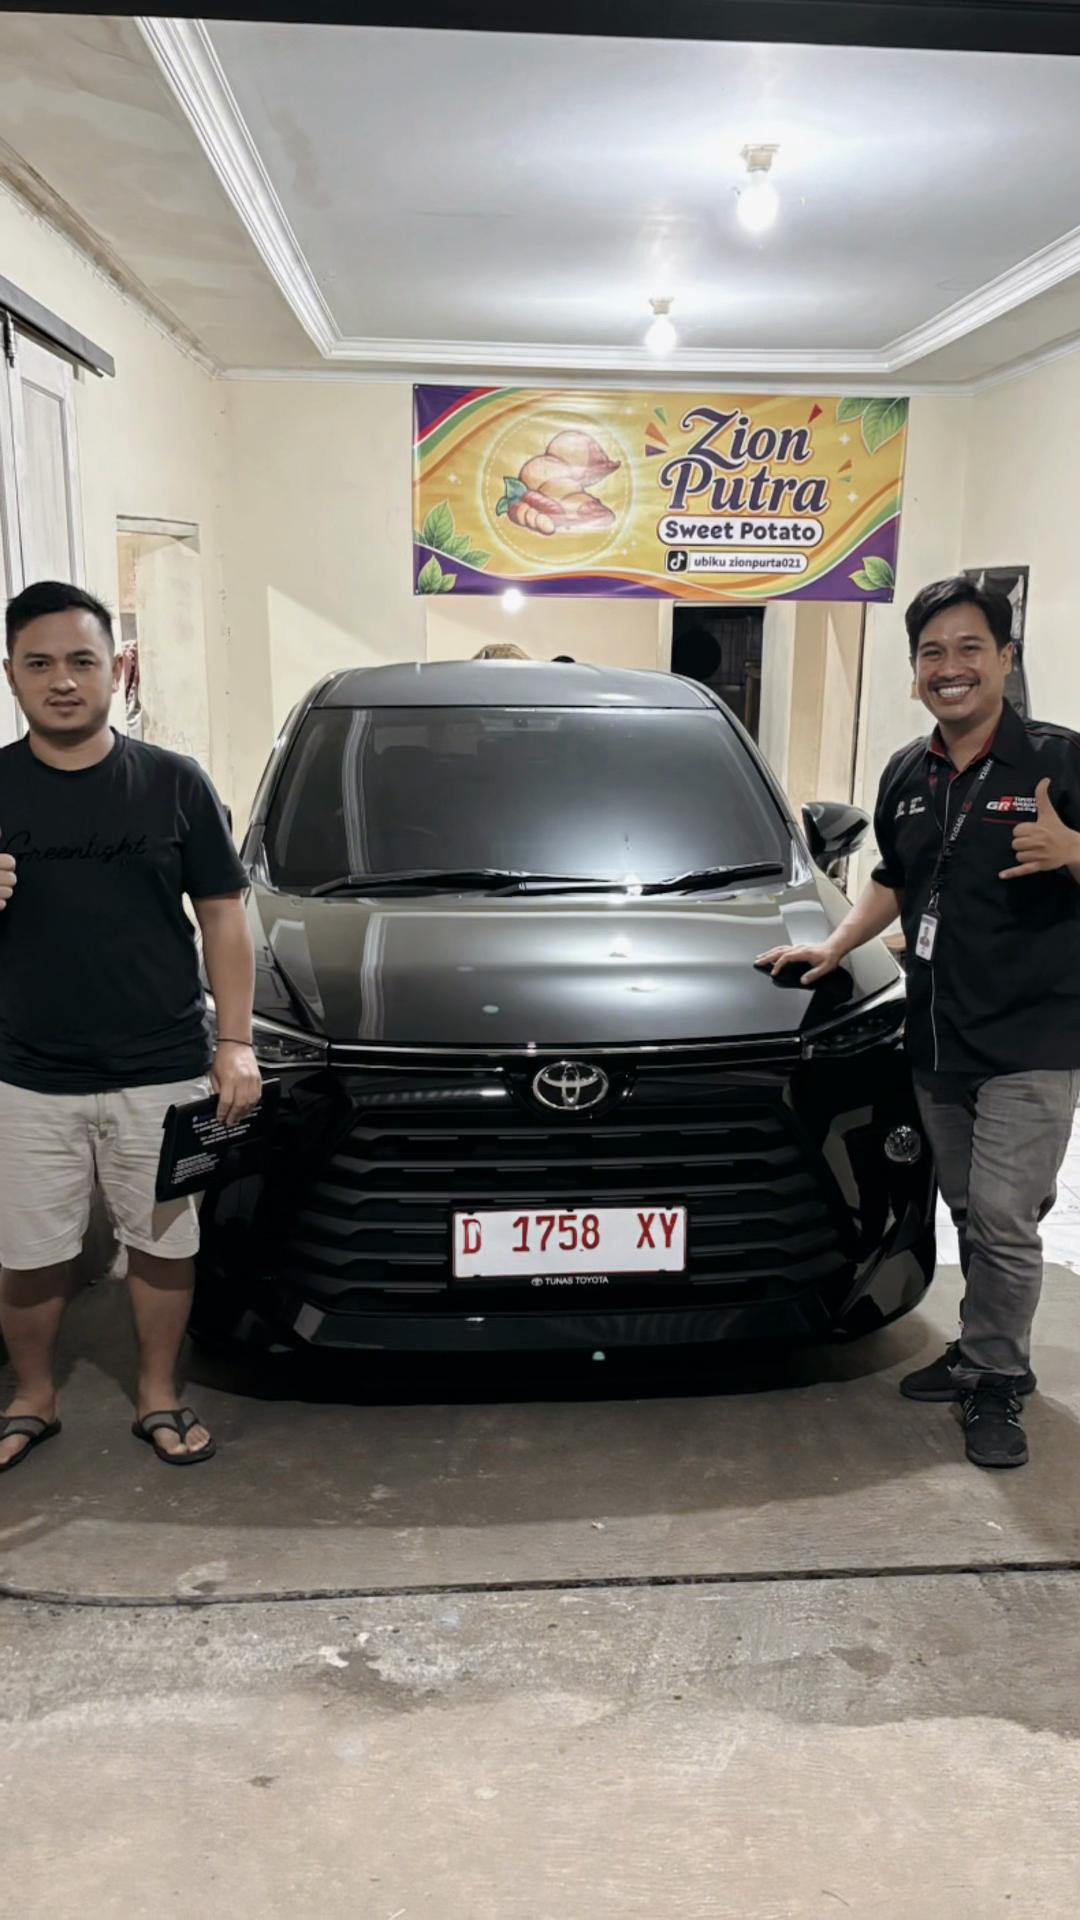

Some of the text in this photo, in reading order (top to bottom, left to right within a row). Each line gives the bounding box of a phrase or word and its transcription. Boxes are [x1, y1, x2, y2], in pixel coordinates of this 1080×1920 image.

[681, 406, 811, 470] Zion
[660, 457, 828, 513] Putra
[665, 520, 816, 541] Sweet Potato
[694, 555, 801, 570] ubiku zionpurta021
[986, 799, 1011, 811] GR
[949, 813, 967, 841] TOYOTA
[462, 1212, 678, 1254] D 1758 XY
[545, 1275, 609, 1285] TUNAS TOYOTA
